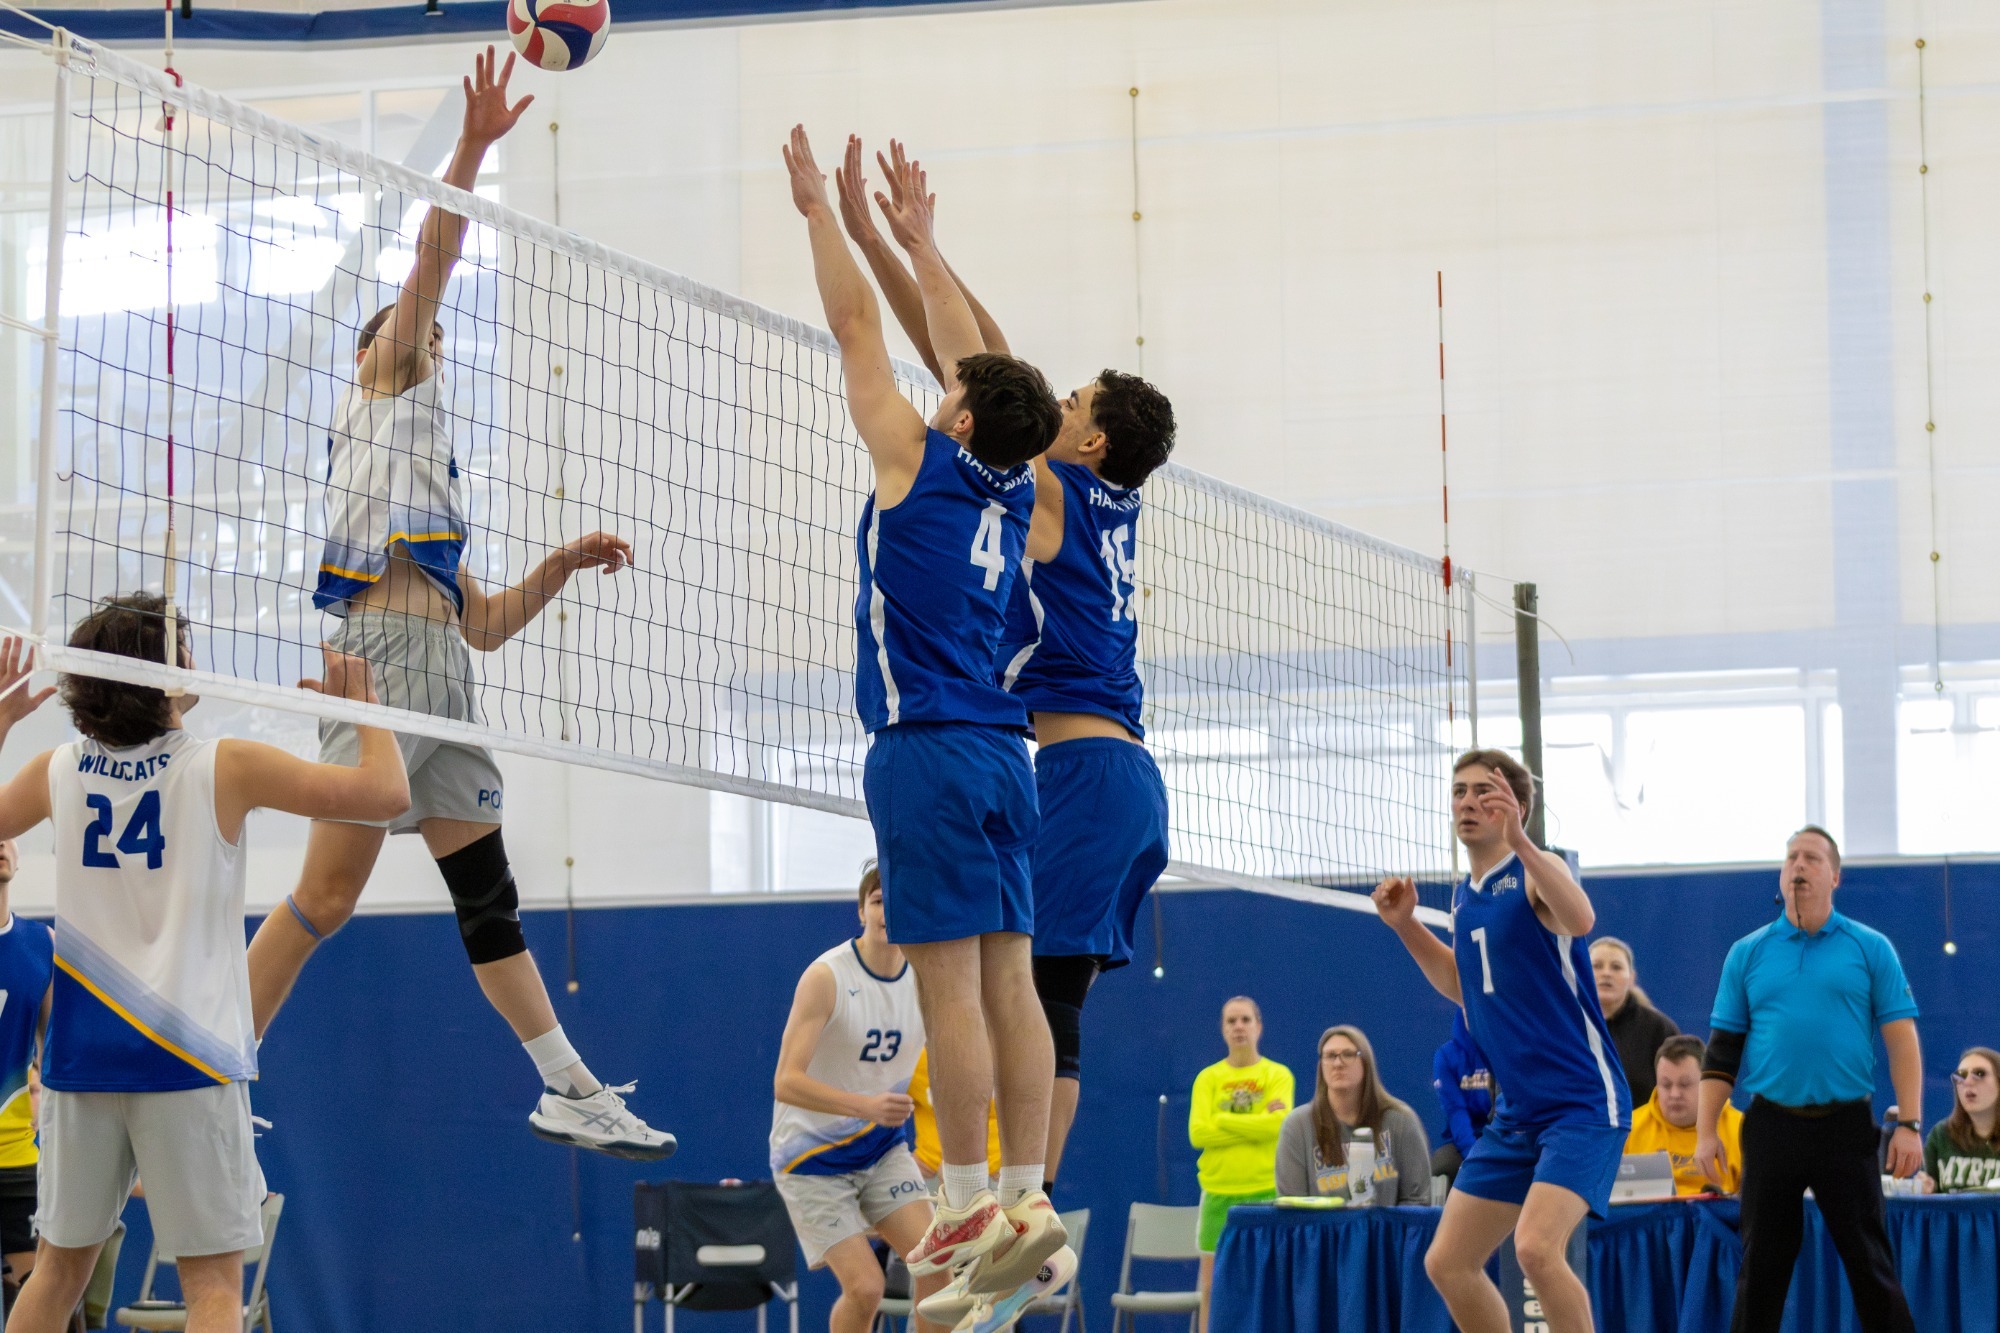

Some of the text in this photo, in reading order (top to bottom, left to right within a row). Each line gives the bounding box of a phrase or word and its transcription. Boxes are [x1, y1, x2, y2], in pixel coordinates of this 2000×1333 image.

[970, 498, 1008, 592] 4
[78, 753, 171, 782] WILDCATS
[478, 789, 504, 810] PO
[82, 789, 166, 870] 24
[1470, 926, 1495, 994] 1
[859, 1028, 902, 1062] 23
[890, 1179, 926, 1199] POL
